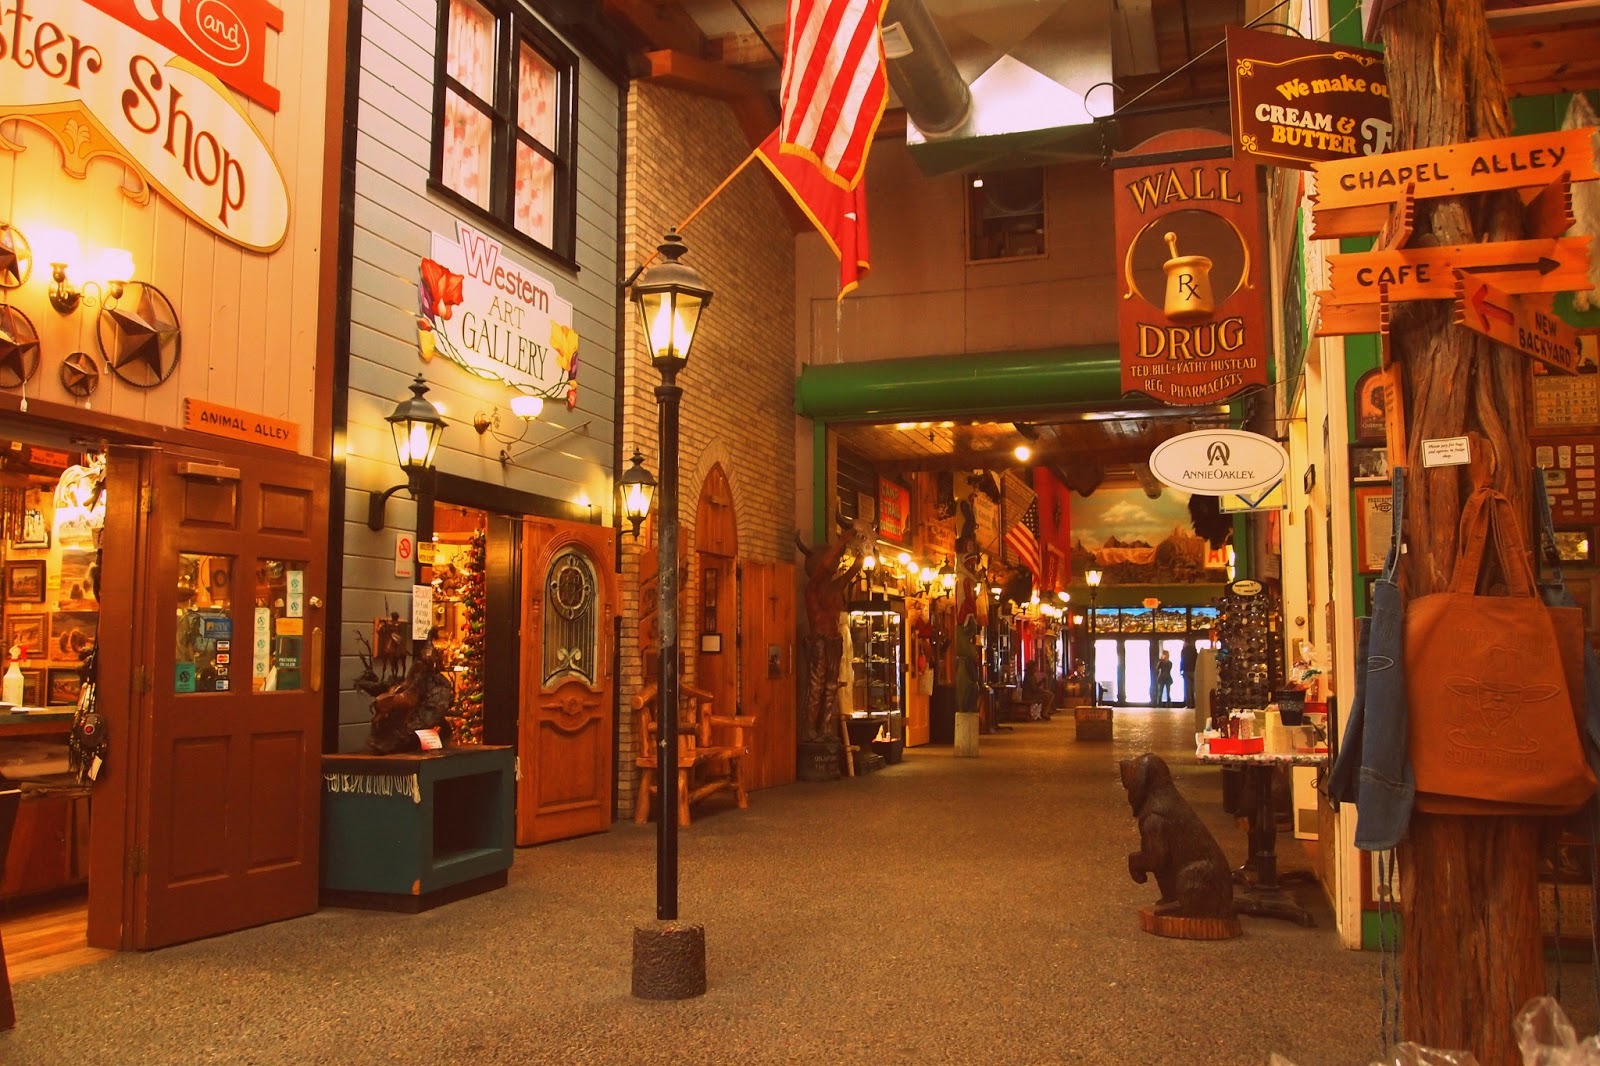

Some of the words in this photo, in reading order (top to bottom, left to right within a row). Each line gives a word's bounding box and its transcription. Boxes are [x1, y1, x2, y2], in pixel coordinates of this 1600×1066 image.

[202, 13, 241, 51] and
[1275, 77, 1309, 101] We
[1310, 74, 1366, 95] make
[1370, 83, 1390, 98] ou
[1254, 103, 1333, 132] CREAM
[1336, 116, 1356, 134] &
[121, 54, 246, 229] Shop
[1271, 124, 1357, 155] BUTTER
[1339, 163, 1449, 193] CHAPEL
[1470, 146, 1566, 177] ALLEY
[1125, 165, 1243, 214] WALL
[461, 228, 549, 314] Western
[1356, 263, 1431, 287] CAFE
[487, 295, 525, 330] ART
[1535, 311, 1557, 336] NEW
[462, 311, 548, 381] GALLERY
[1137, 317, 1245, 361] DRUG
[1518, 328, 1571, 366] BACKYARD
[1177, 361, 1208, 374] KATHY
[1210, 358, 1257, 371] HUSTEAD
[1144, 379, 1165, 393] REG.
[1170, 373, 1243, 398] PHARMACISTS
[200, 410, 247, 432] ANIMAL
[254, 423, 290, 440] ALLEY
